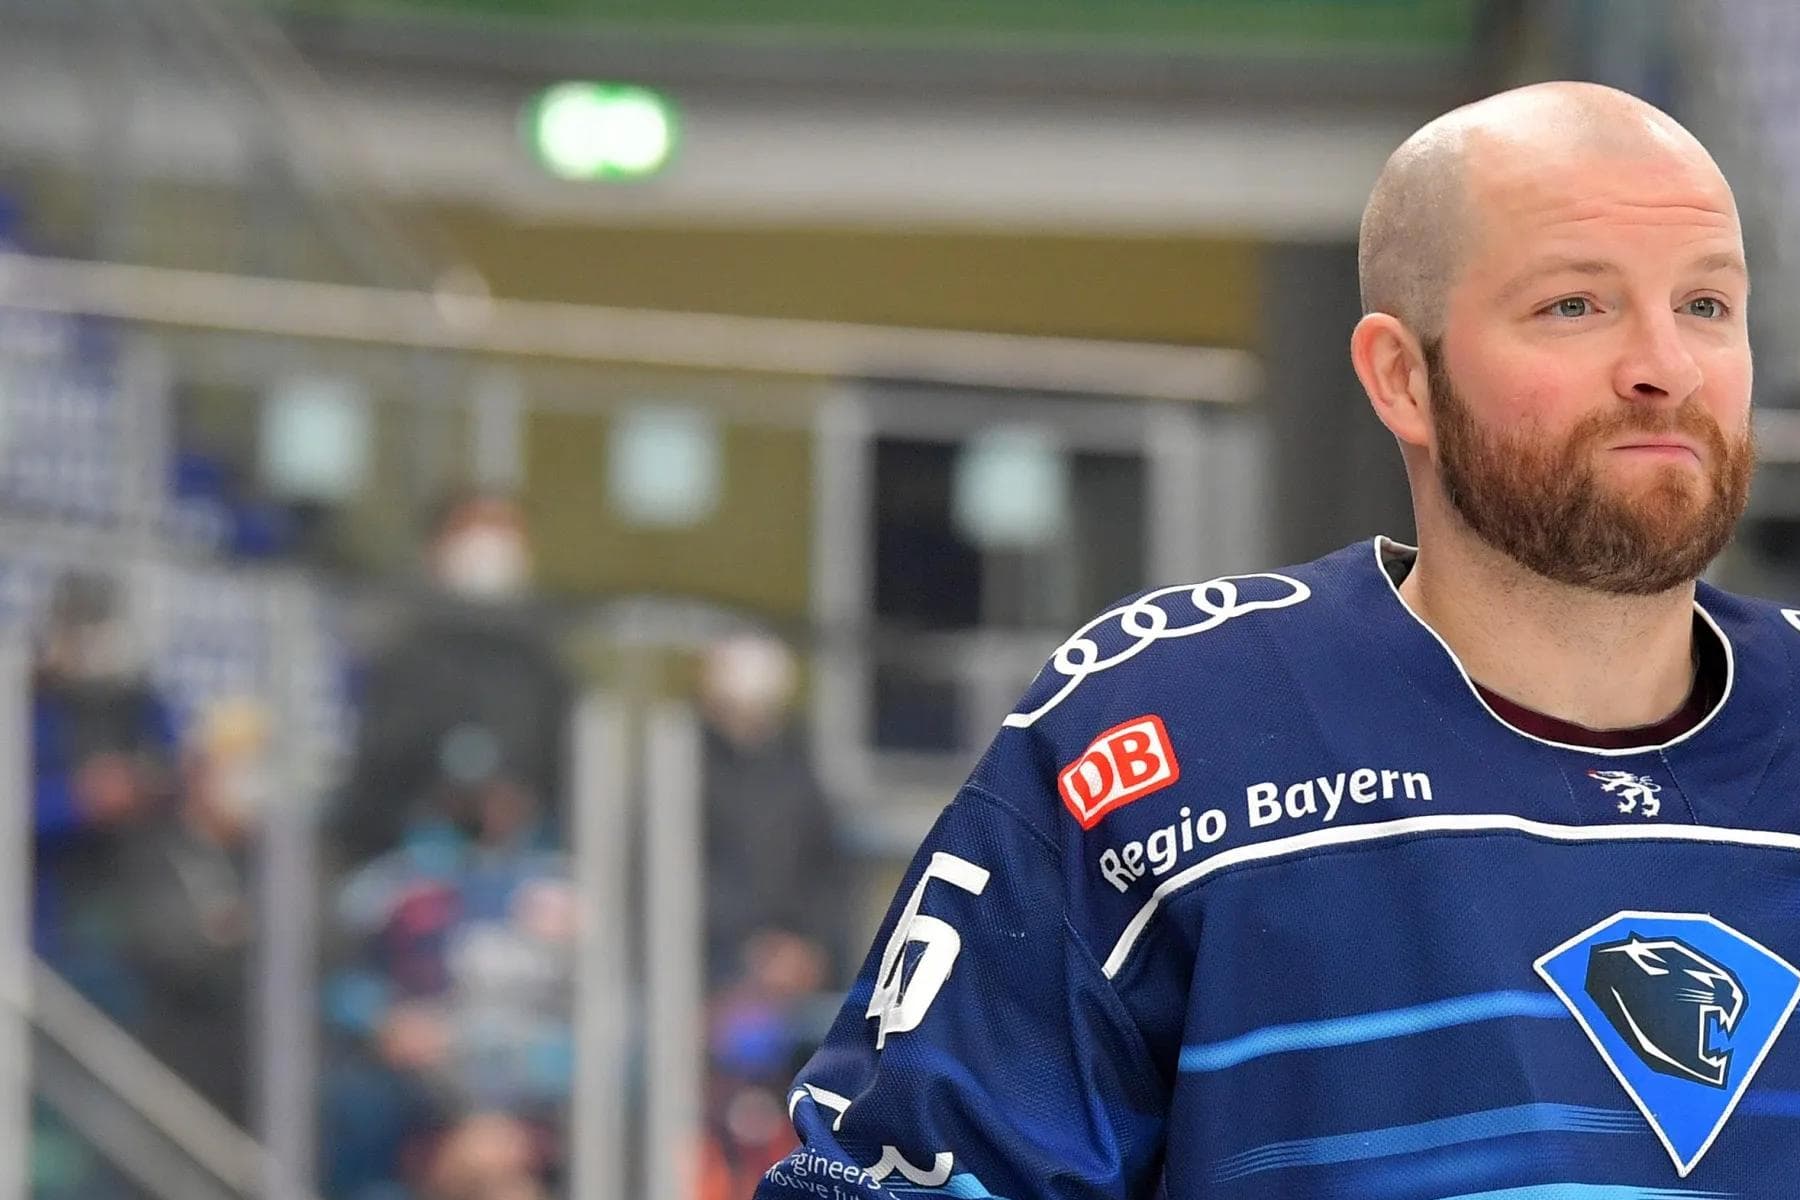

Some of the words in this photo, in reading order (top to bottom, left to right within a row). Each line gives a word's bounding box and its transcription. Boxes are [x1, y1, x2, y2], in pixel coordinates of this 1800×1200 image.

[1069, 727, 1168, 816] DB
[1101, 807, 1227, 892] Regio
[1246, 767, 1433, 829] Bayern
